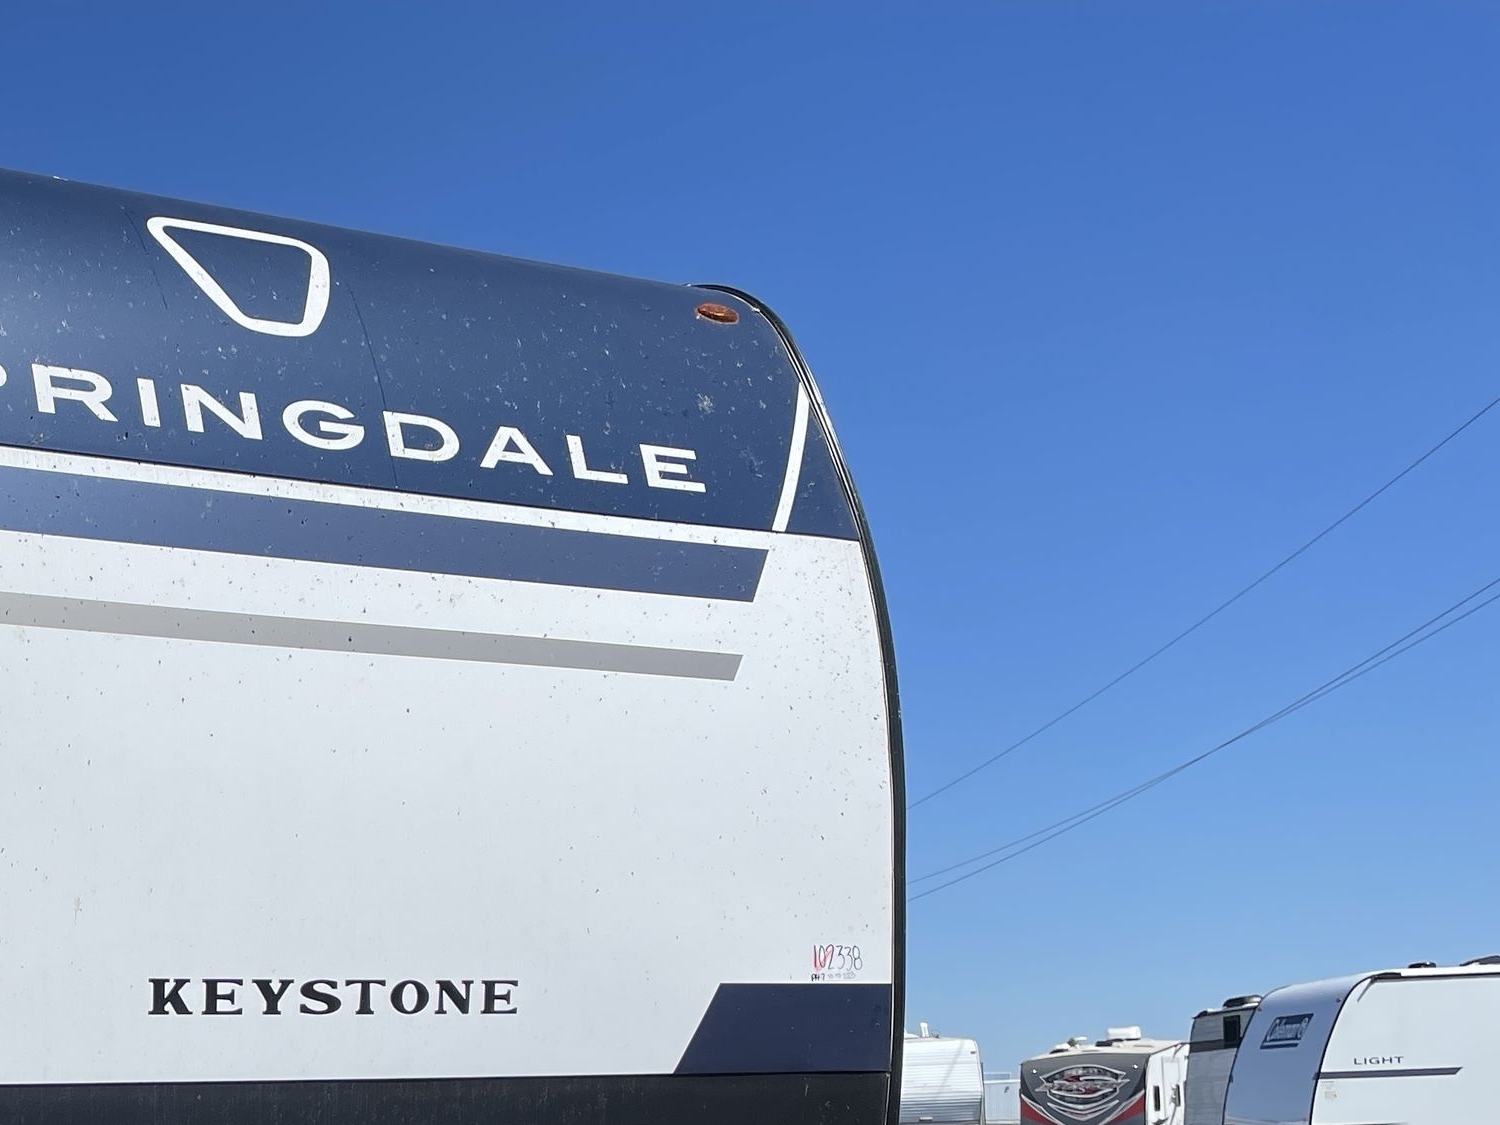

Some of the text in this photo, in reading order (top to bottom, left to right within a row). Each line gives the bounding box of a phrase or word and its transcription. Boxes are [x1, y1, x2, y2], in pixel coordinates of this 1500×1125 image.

[812, 944, 863, 972] 102338
[147, 977, 519, 1016] KEYSTONE
[1353, 1056, 1404, 1066] LIGHT
